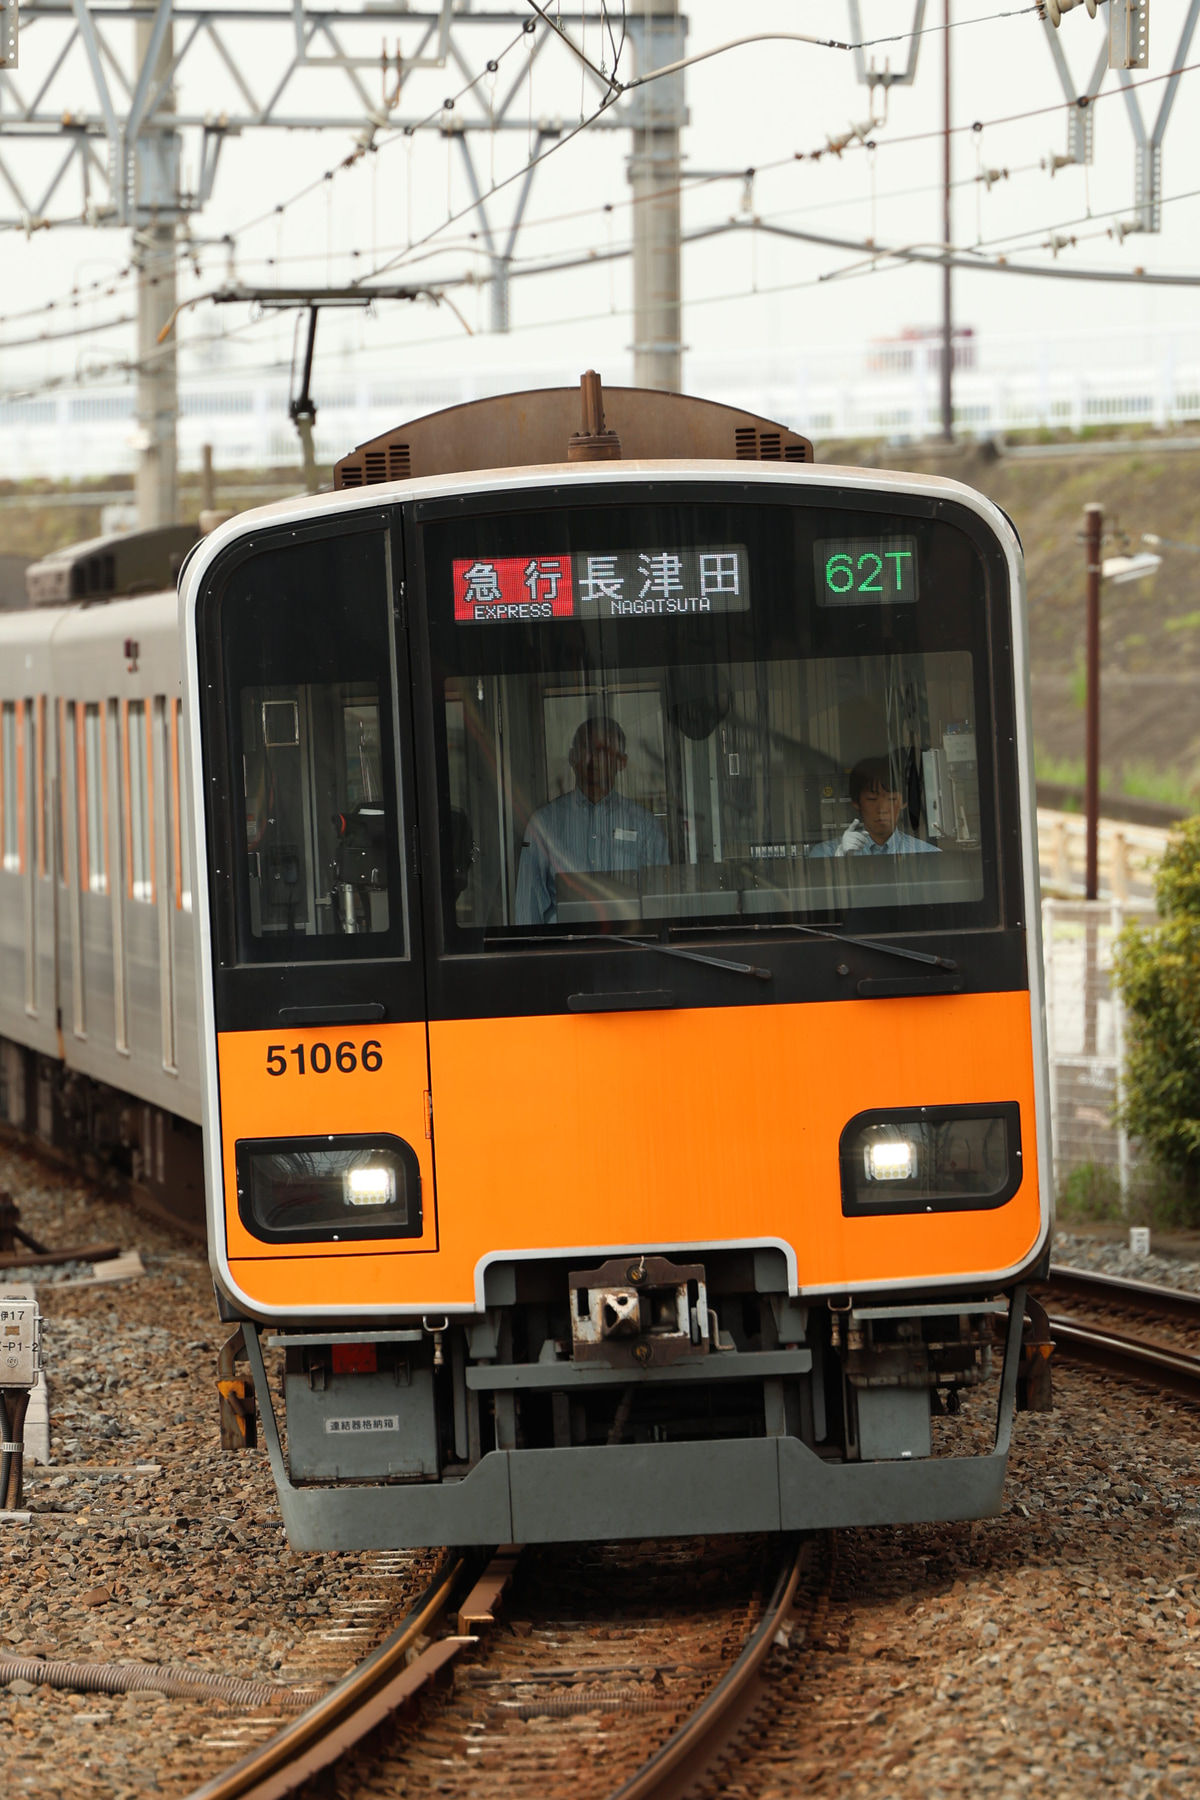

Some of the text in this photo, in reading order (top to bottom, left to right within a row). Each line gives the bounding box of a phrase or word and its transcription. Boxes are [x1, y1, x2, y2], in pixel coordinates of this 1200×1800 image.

[464, 560, 562, 601] 急行
[579, 552, 739, 600] 長津田
[826, 552, 912, 592] 62T
[474, 603, 552, 620] EXPRESS
[610, 597, 711, 615] NAGATSUTA
[266, 1040, 383, 1076] 51066
[330, 1418, 394, 1431] 連結器格納箱
